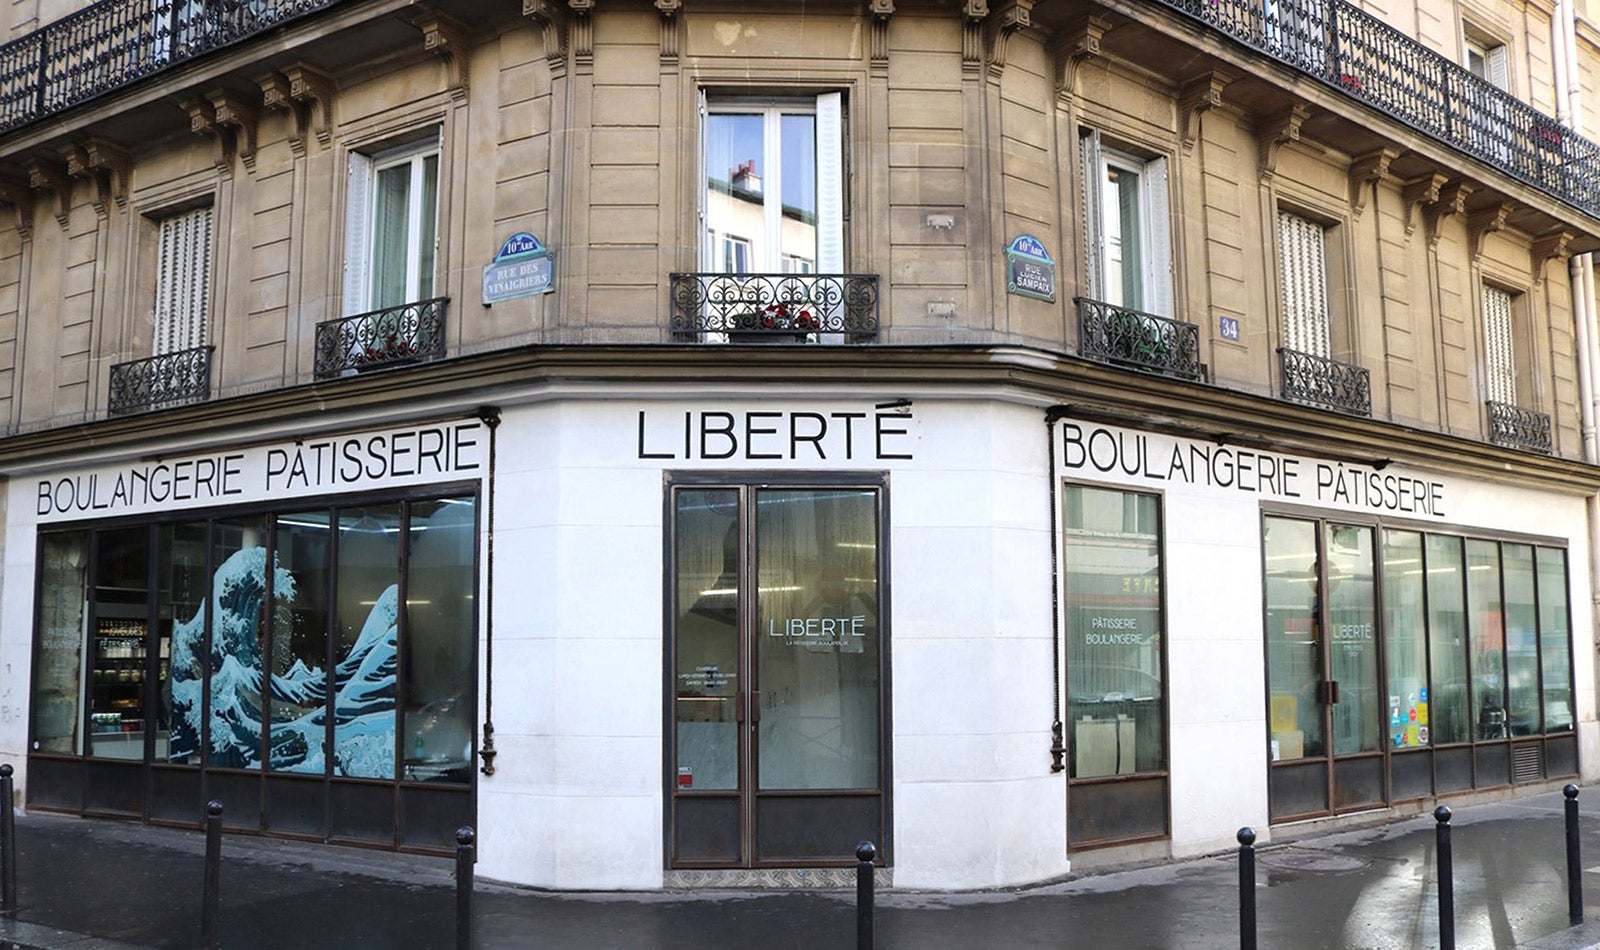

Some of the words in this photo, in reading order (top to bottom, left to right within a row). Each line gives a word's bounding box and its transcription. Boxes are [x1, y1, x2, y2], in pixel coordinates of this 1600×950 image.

[497, 268, 517, 281] RUE
[520, 263, 539, 275] DES
[1025, 263, 1041, 276] RUE
[1016, 276, 1050, 293] SAMPAIX
[1222, 318, 1237, 338] 34
[638, 400, 913, 460] LIBERTÉ
[37, 454, 244, 516] BOULANGERIE
[266, 423, 481, 492] PÂTISSERIE
[1062, 422, 1300, 498] BOULANGERIE
[1317, 461, 1445, 517] PÂTISSERIE
[769, 614, 866, 637] LIBERTÉ
[1086, 633, 1144, 645] BOULANGERIE
